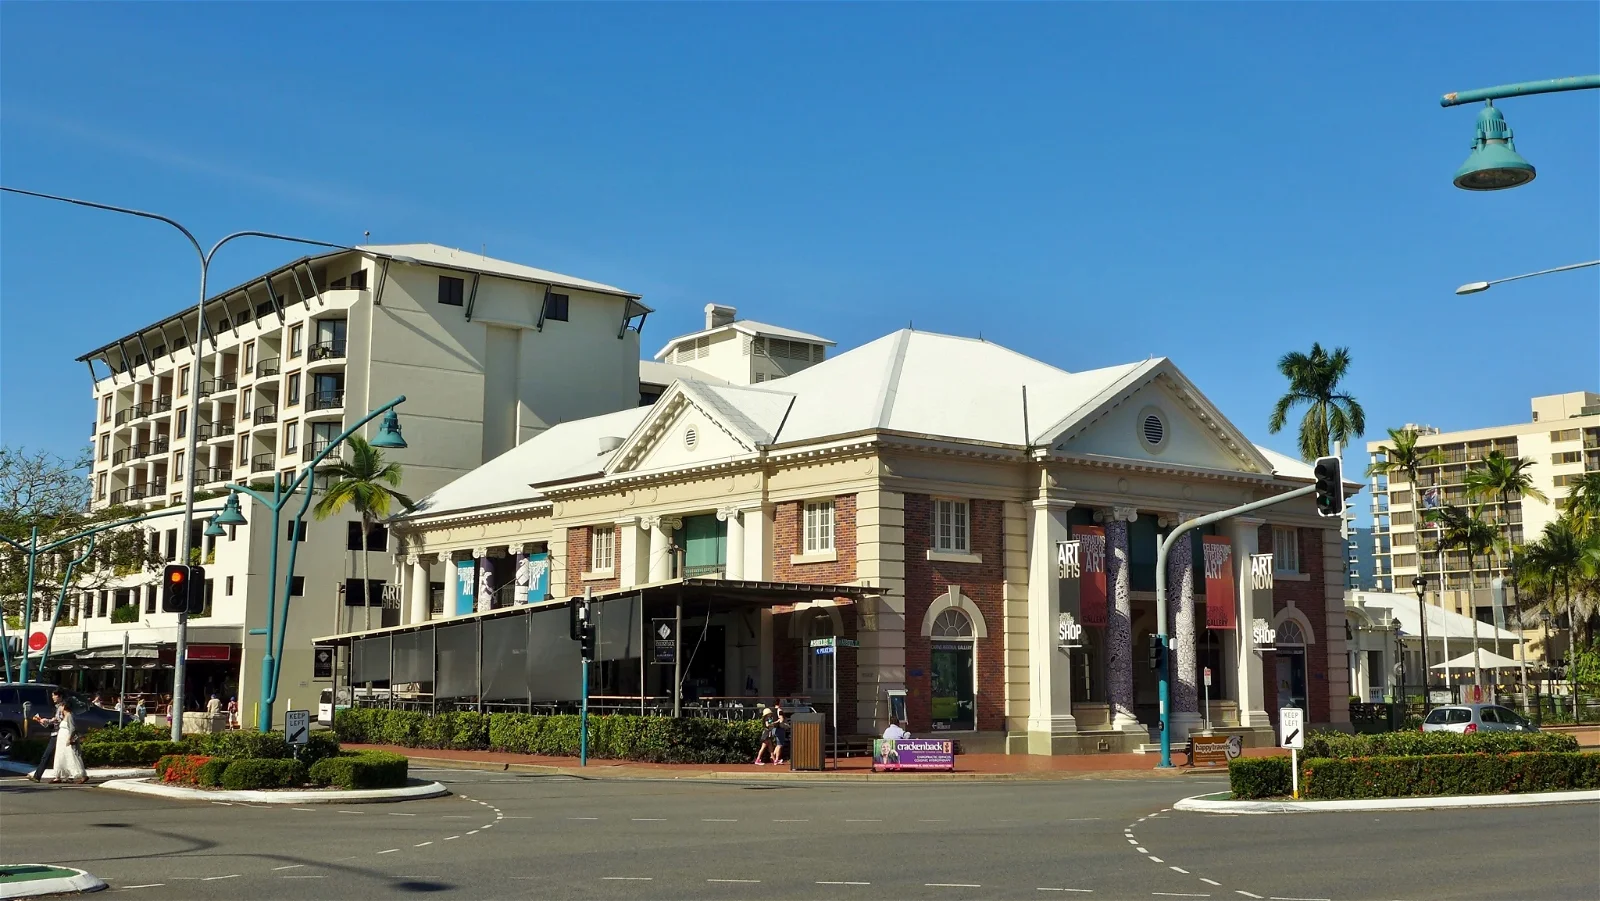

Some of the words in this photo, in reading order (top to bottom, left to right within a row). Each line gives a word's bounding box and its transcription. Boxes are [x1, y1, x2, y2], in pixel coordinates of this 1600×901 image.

[1058, 543, 1080, 565] ART
[1058, 563, 1080, 578] GIFTS
[1086, 554, 1106, 572] ART
[1204, 560, 1222, 579] ART
[1252, 556, 1273, 576] ART
[463, 579, 474, 595] ART
[528, 572, 540, 591] ART
[1252, 574, 1273, 590] NOW
[382, 586, 400, 600] ART
[382, 600, 400, 609] GIFTS
[1059, 624, 1082, 640] SHOP
[1253, 629, 1276, 644] SHOP
[1284, 711, 1298, 719] KEEP
[897, 741, 942, 751] crackenback
